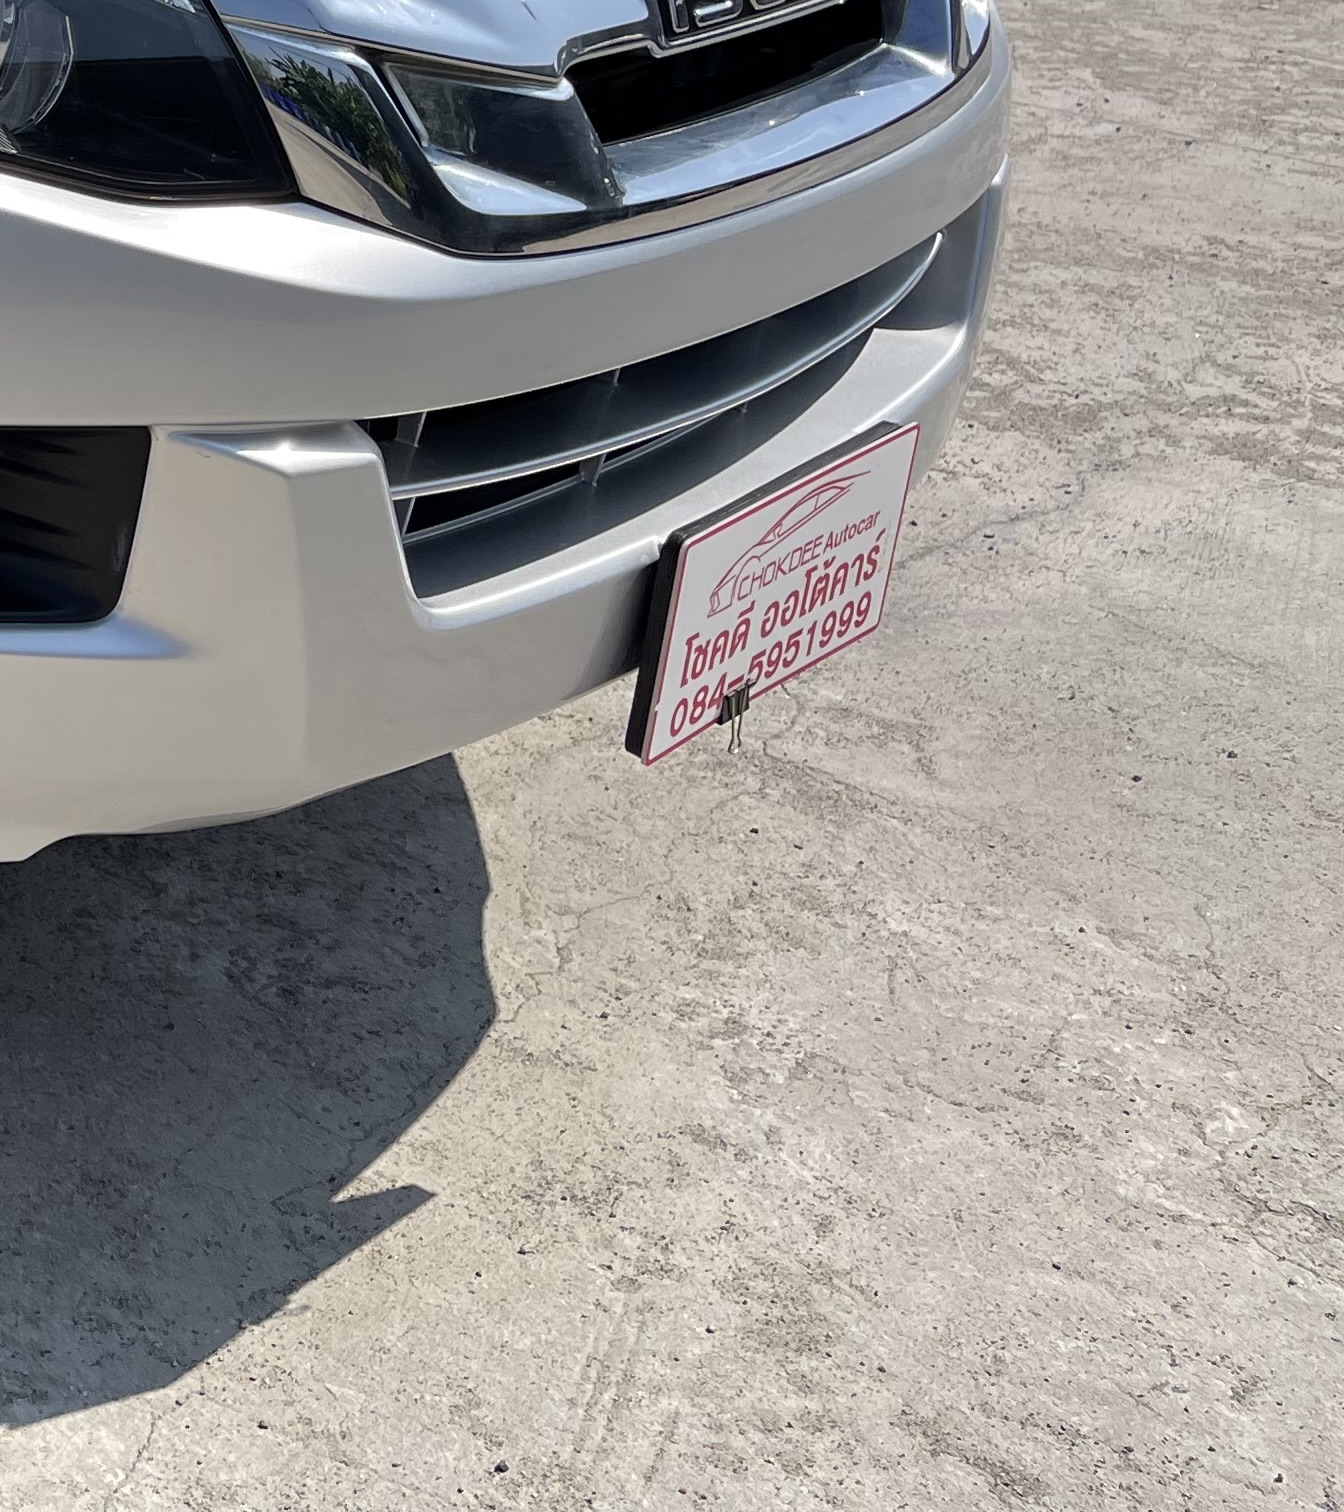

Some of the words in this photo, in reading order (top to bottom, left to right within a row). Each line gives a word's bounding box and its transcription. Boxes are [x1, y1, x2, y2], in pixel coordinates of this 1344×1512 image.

[680, 600, 756, 687] โชคดี
[760, 528, 886, 638] ออโต้คาร์
[735, 534, 824, 600] CHOKDEE
[822, 510, 882, 554] Autocar
[670, 591, 873, 737] 084-5951999
